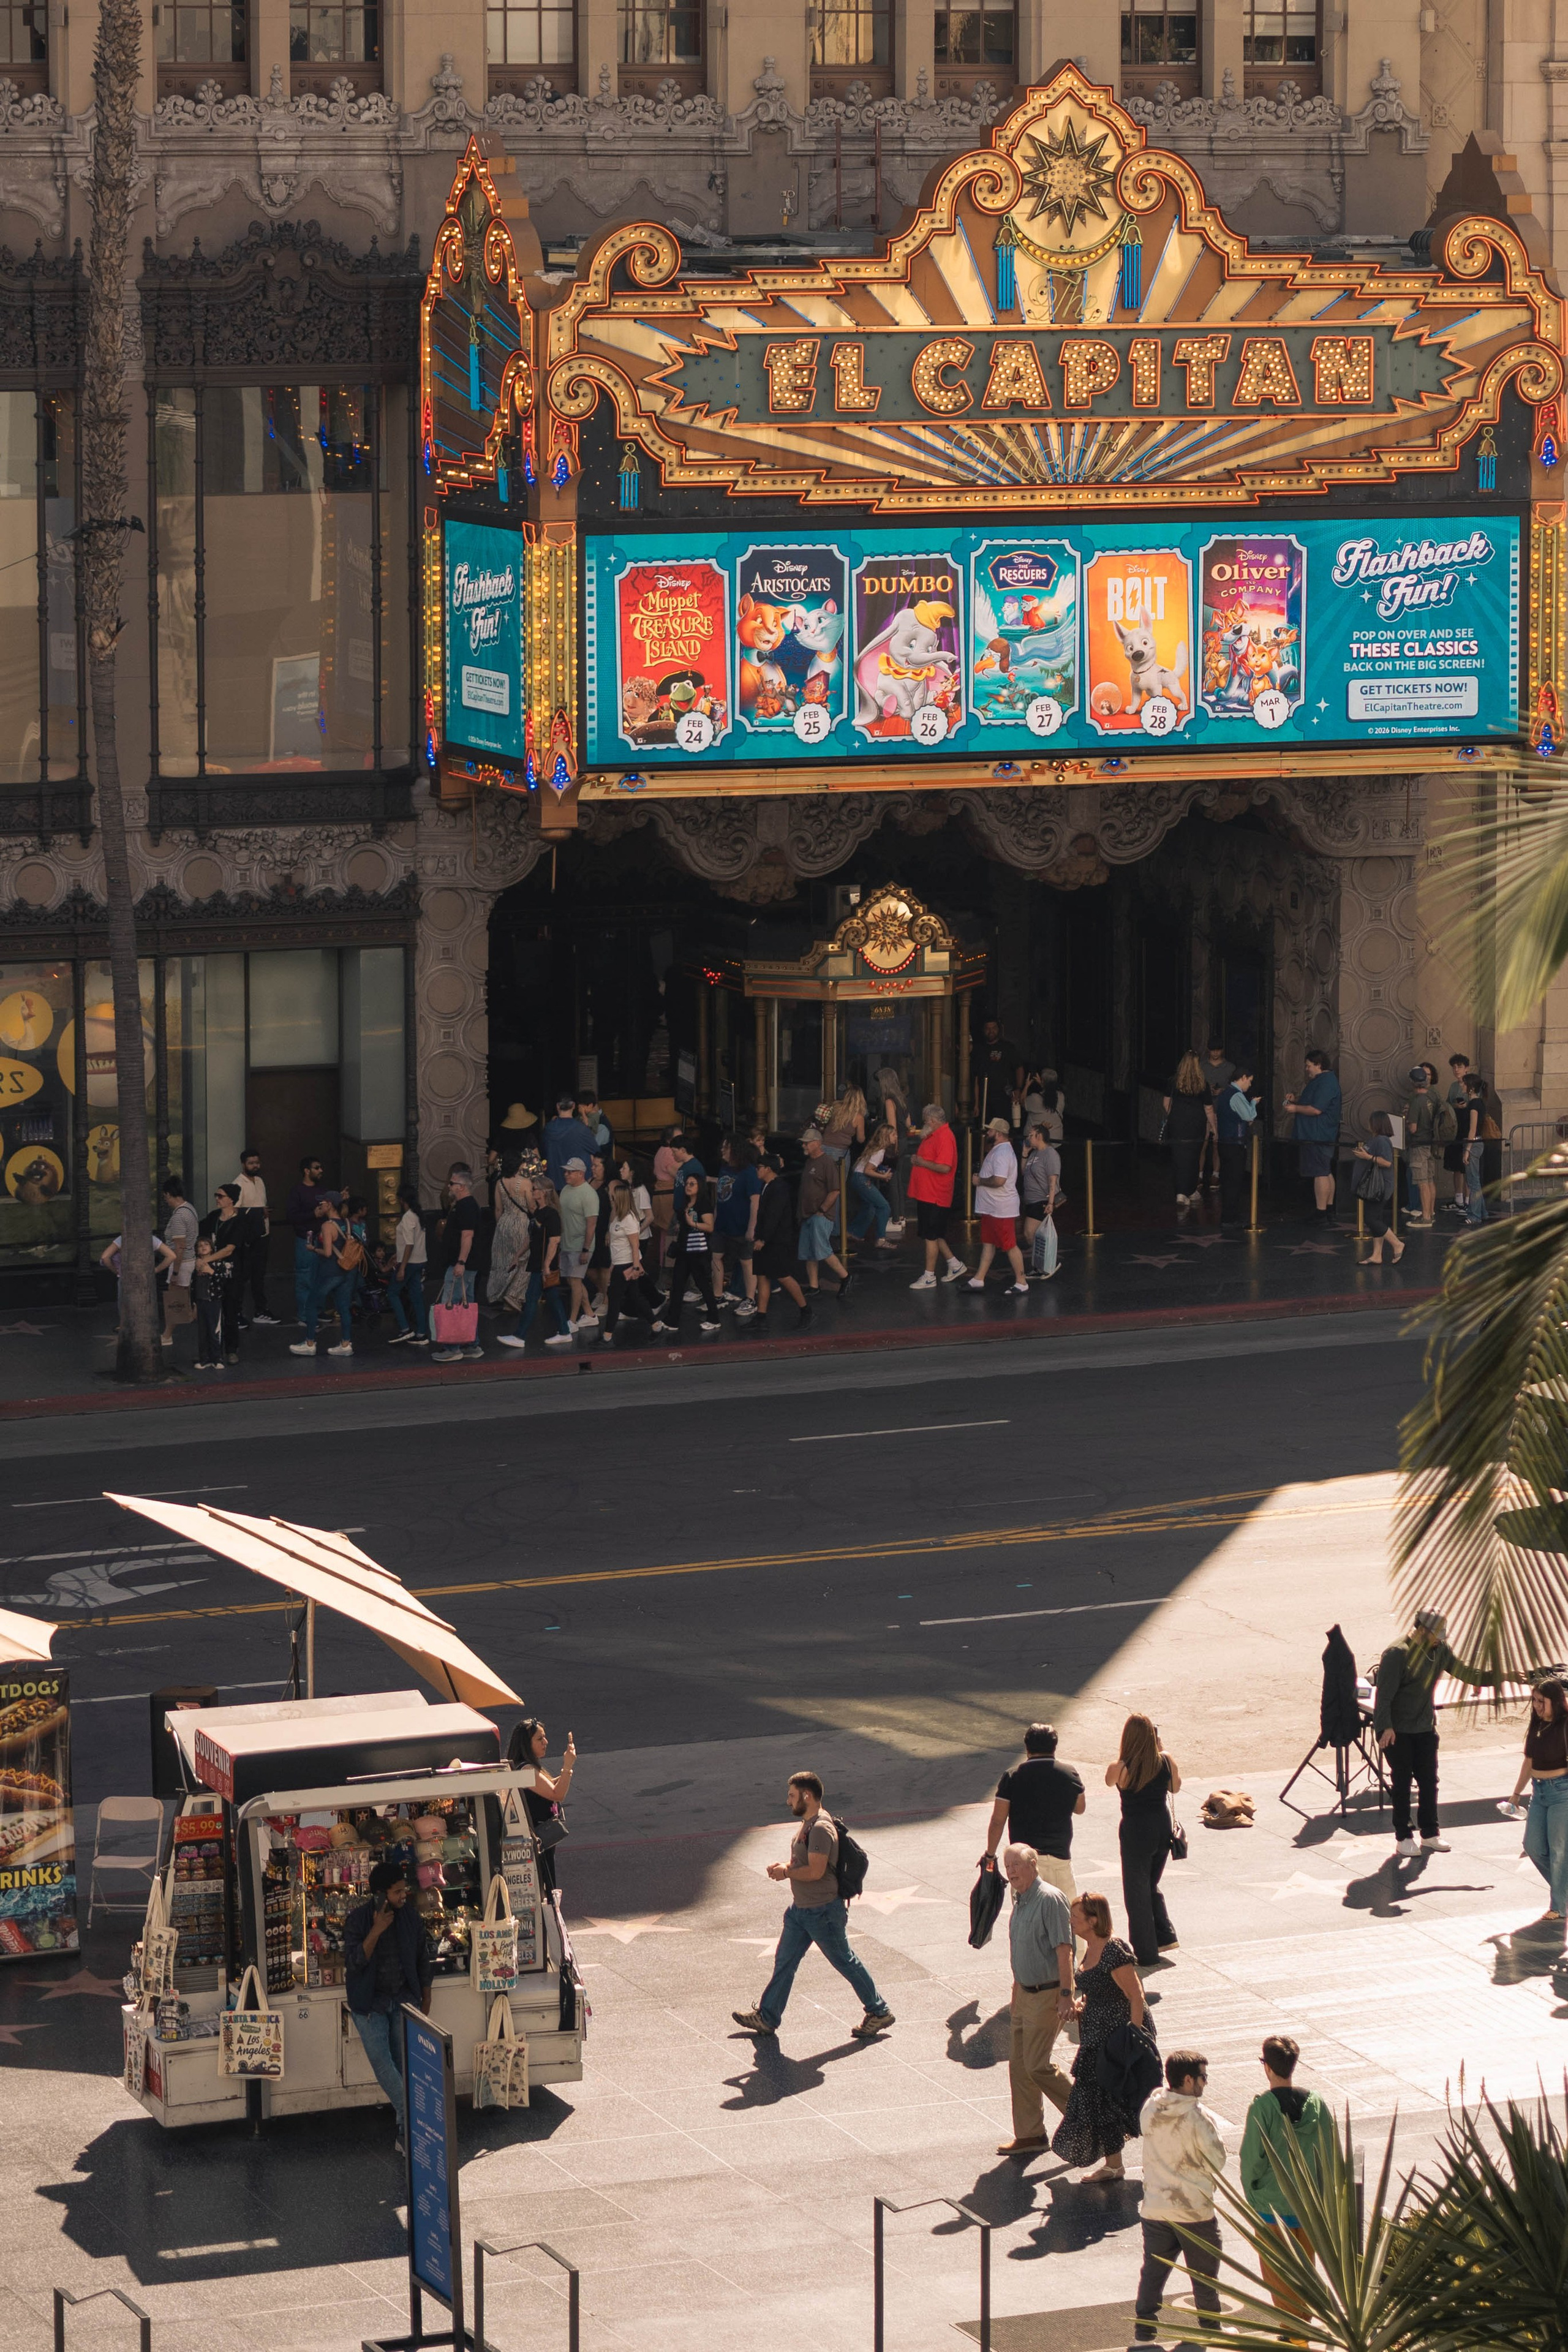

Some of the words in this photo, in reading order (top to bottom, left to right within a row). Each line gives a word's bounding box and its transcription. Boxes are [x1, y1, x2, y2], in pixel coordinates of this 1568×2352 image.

[1026, 273, 1102, 322] The
[763, 339, 882, 413] EL
[911, 333, 1378, 417] CAPITAN
[1011, 555, 1033, 565] Disney
[1236, 549, 1267, 564] Disney
[1333, 532, 1492, 586] Flashback
[772, 560, 809, 576] Disney
[901, 568, 916, 578] Disney
[1126, 564, 1150, 575] Disney
[1210, 562, 1291, 581] Oliver
[654, 575, 692, 590] Disney
[999, 567, 1047, 586] RESCUERS
[453, 562, 514, 610] Flashback
[751, 572, 831, 597] ARISTOCATS
[862, 575, 954, 595] DUMBO
[1221, 586, 1282, 598] COMPANY
[639, 589, 703, 618] Muppet
[1107, 576, 1167, 621] BOLT
[1378, 574, 1458, 618] Fun!
[470, 606, 500, 650] Fun!
[629, 614, 714, 641] TREASURE
[1353, 631, 1376, 640] POP
[1378, 630, 1395, 639] ON
[1397, 630, 1427, 639] OVER
[1429, 629, 1453, 639] AND
[1455, 628, 1474, 638] SEE
[643, 639, 701, 668] ISLAND
[1350, 643, 1400, 658] THESE
[1404, 640, 1478, 657] CLASSICS
[1344, 662, 1373, 672] BACK
[1376, 662, 1392, 671] ON
[1395, 661, 1415, 671] THE
[1418, 660, 1437, 670] BIG
[1439, 659, 1485, 669] SCREEN!
[475, 674, 492, 686] TICKETS
[493, 678, 505, 690] NOW!
[1360, 685, 1382, 695] GET
[1385, 684, 1432, 694] TICKETS
[1435, 682, 1467, 693] NOW!
[1036, 703, 1052, 712] FEB
[1152, 704, 1167, 713] FEB
[1261, 697, 1280, 707] MAR
[1364, 702, 1463, 714] ElCapitanTheatre.com
[803, 710, 820, 720] FEB
[1036, 714, 1053, 728] 27
[1150, 715, 1166, 729] 28
[1270, 709, 1275, 721] 1
[804, 721, 821, 736] 25
[920, 723, 937, 737] 26
[1413, 726, 1447, 734] Enterprises
[685, 730, 703, 744] 24
[0, 1680, 59, 1699] TDOGS
[195, 1730, 231, 1777] SOUVENIR
[196, 1757, 230, 1796] KIOSK
[181, 1820, 216, 1835] $5.99
[502, 1849, 531, 1861] LYWOOD
[0, 1866, 62, 1890] RINKS
[478, 1930, 495, 1939] LOS
[222, 2015, 247, 2024] SANTA
[250, 2015, 280, 2024] MONICA
[246, 2034, 260, 2046] Los
[236, 2044, 271, 2060] Angeles
